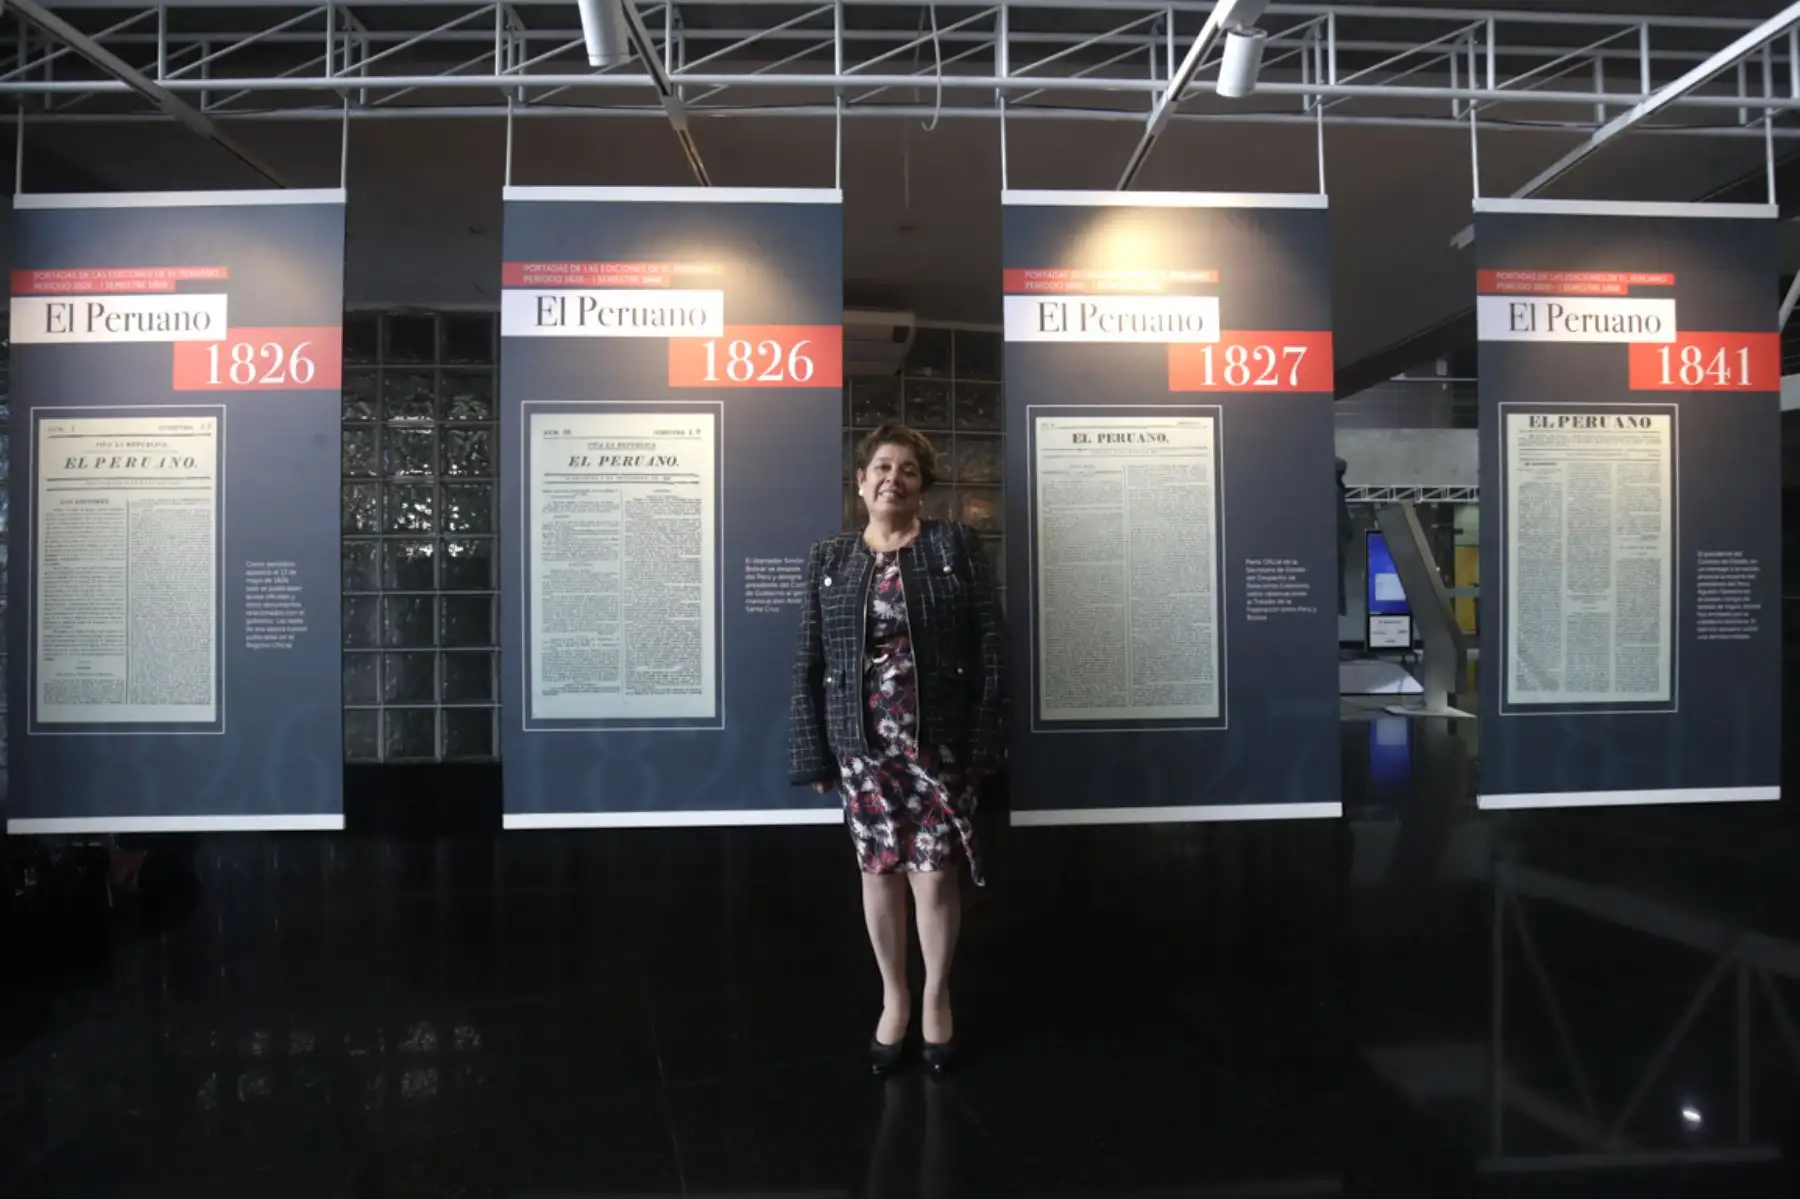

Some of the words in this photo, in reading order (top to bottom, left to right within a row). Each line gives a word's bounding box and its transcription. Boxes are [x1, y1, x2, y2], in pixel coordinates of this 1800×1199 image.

[45, 302, 74, 333] El
[87, 301, 211, 333] Peruano
[535, 295, 566, 327] El
[576, 295, 707, 327] Peruano
[1038, 301, 1068, 332] El
[1080, 302, 1203, 333] Peruano
[1509, 302, 1536, 332] El
[1546, 303, 1661, 334] Peruano
[205, 341, 316, 385] 1826
[702, 338, 814, 383] 1826
[1200, 344, 1308, 387] 1827
[1656, 345, 1753, 387] 1841
[1528, 415, 1554, 428] EL
[1558, 415, 1652, 428] PERUANO
[1072, 432, 1092, 444] EL
[62, 456, 88, 470] EL
[568, 455, 591, 468] EL
